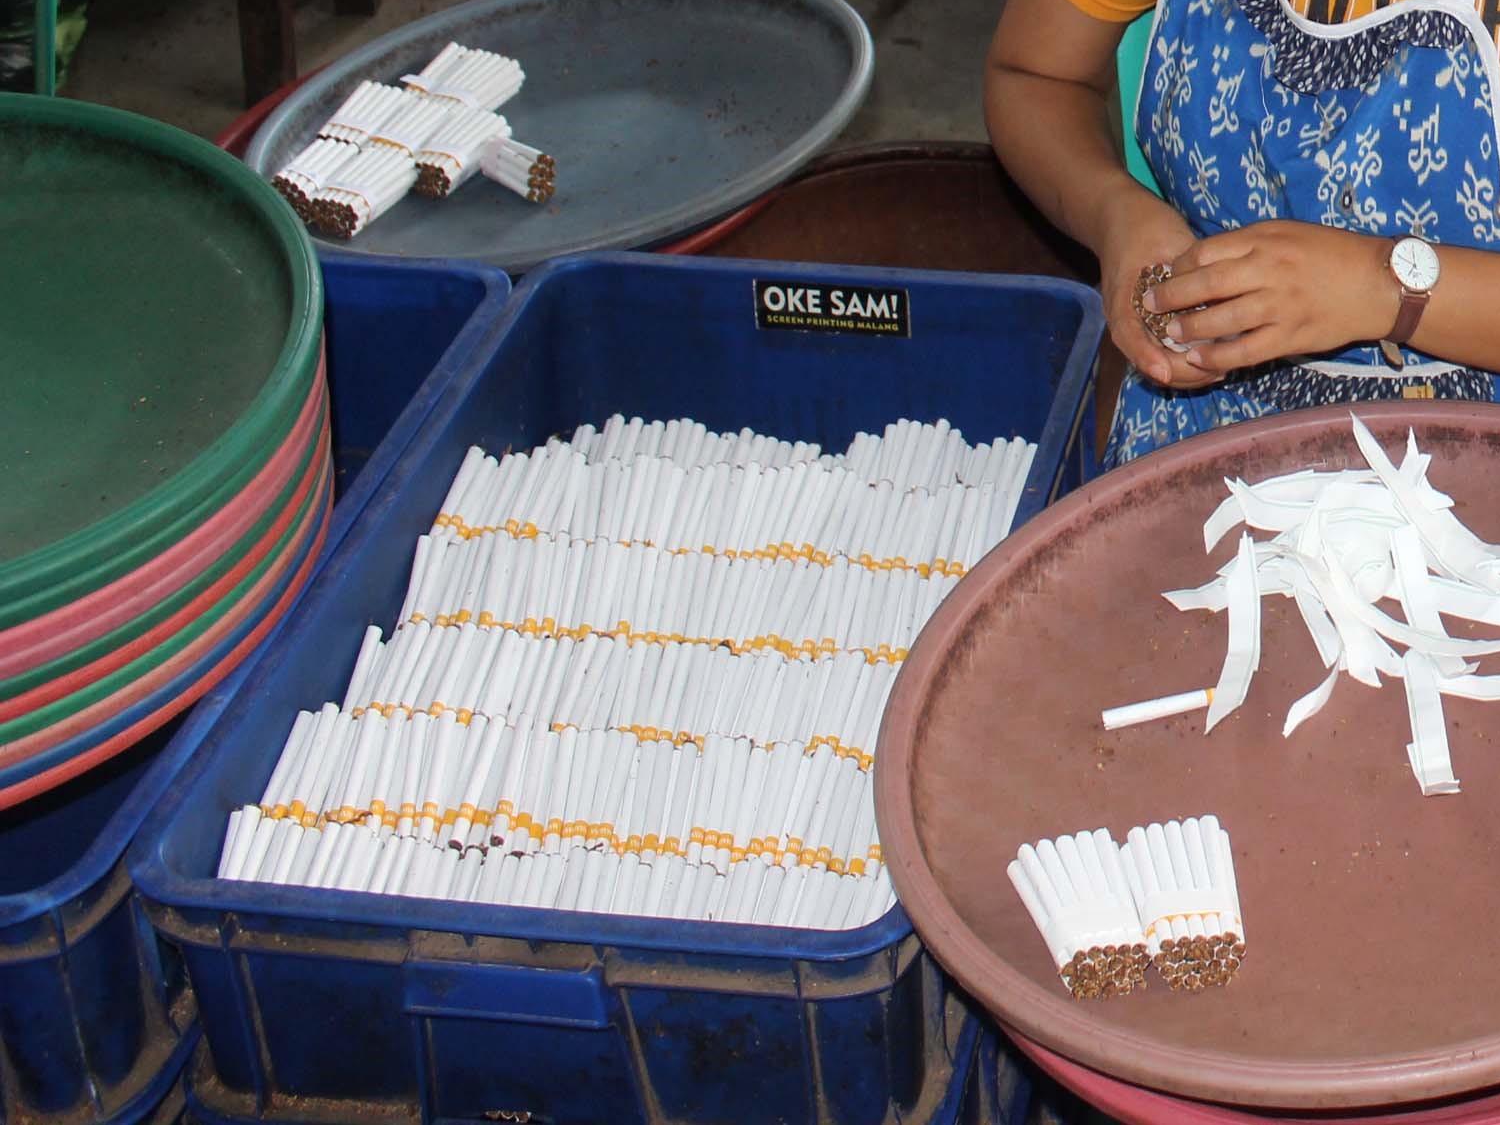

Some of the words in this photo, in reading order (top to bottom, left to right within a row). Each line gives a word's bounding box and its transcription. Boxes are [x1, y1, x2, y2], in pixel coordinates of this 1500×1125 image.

[764, 286, 822, 313] OKE
[830, 290, 898, 319] SAM!
[767, 315, 803, 324] SCREEN
[807, 317, 854, 328] PRINTING
[857, 322, 898, 331] MALANG
